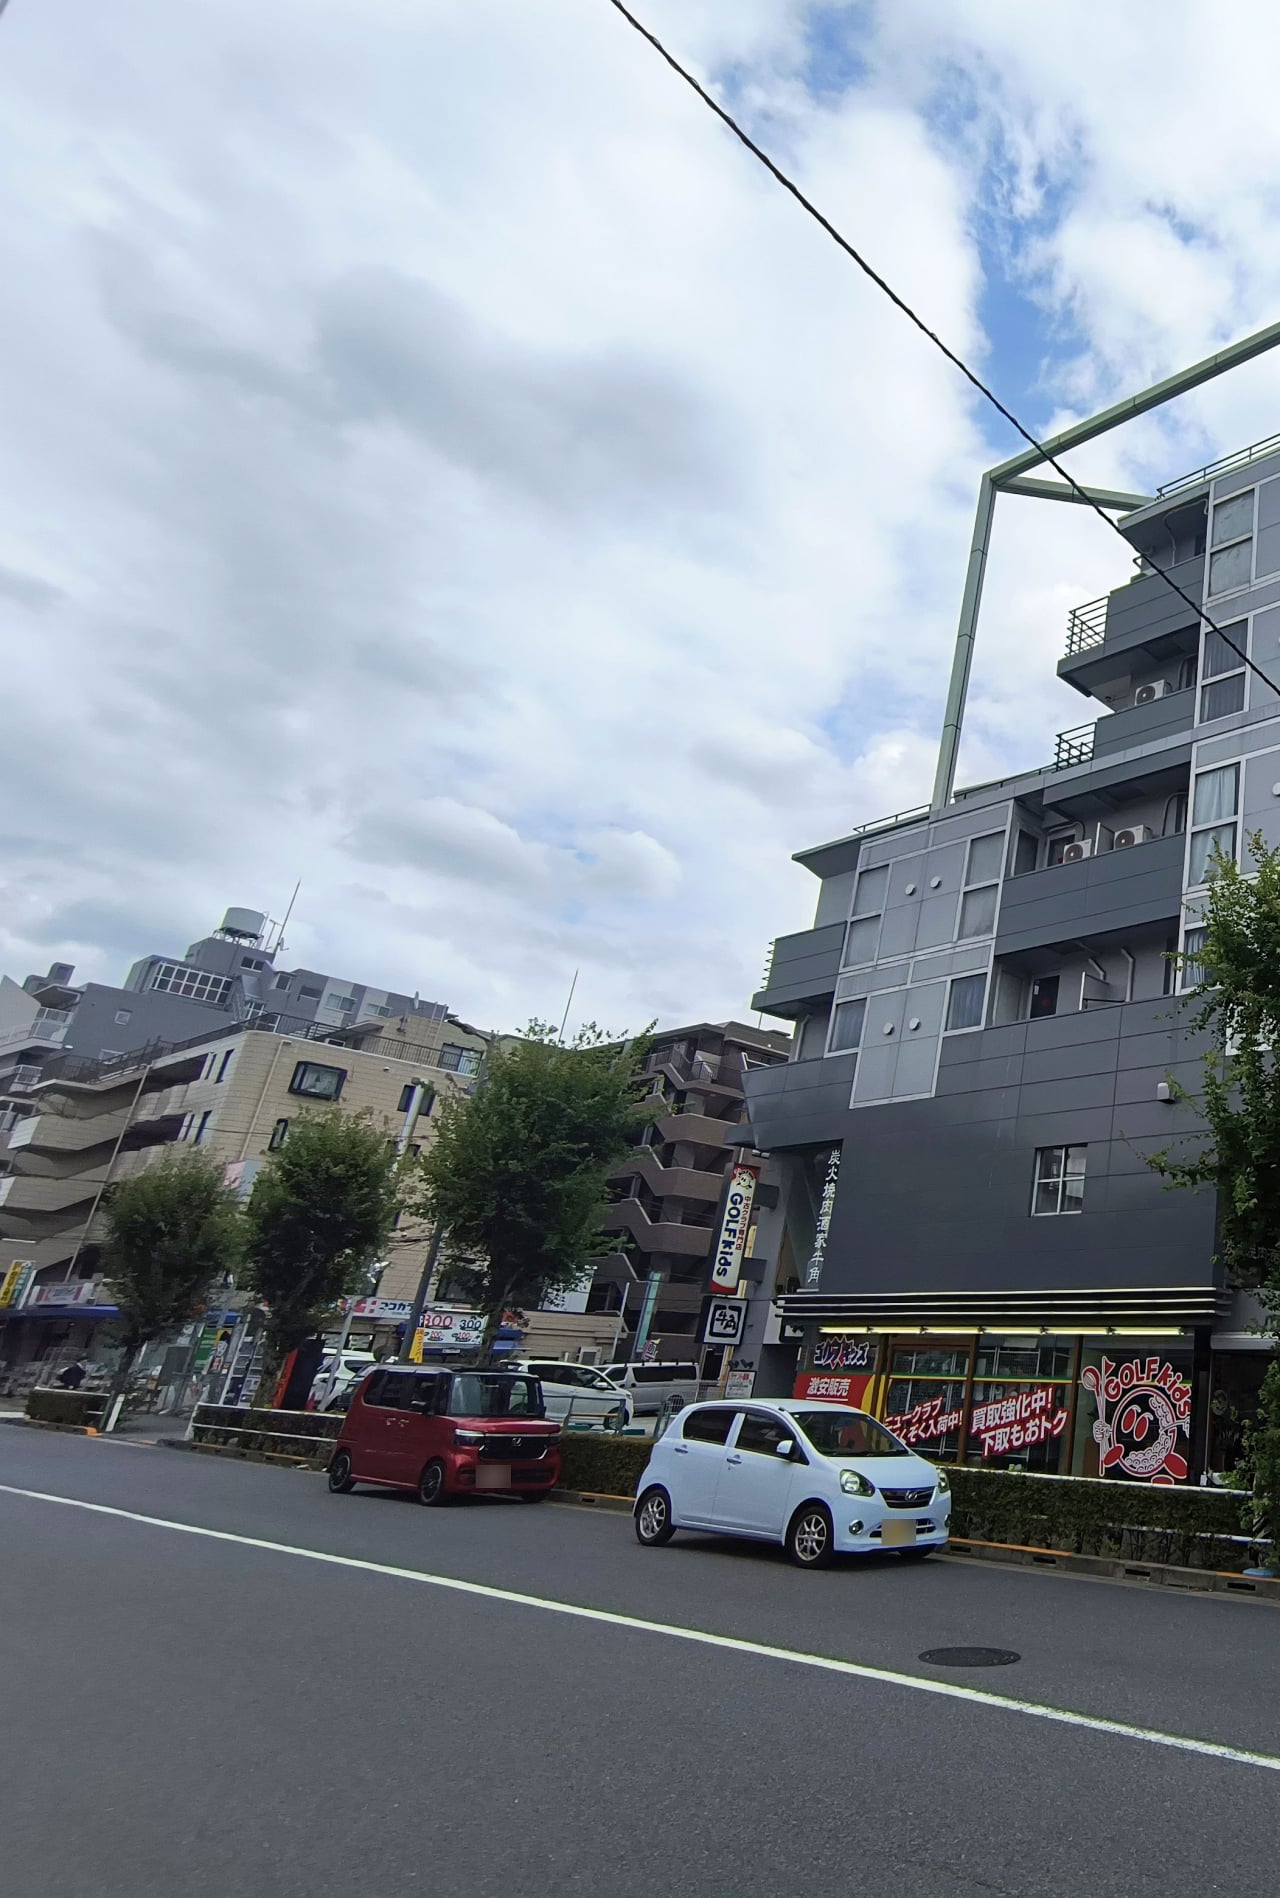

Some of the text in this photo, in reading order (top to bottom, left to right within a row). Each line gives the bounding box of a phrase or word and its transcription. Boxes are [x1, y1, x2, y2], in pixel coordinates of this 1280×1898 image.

[808, 1149, 840, 1283] 炭火焼肉酒家牛角
[807, 1377, 851, 1395] 激安販売
[971, 1388, 1053, 1433] 買取強化中!
[980, 1411, 1068, 1457] 下取もおトク
